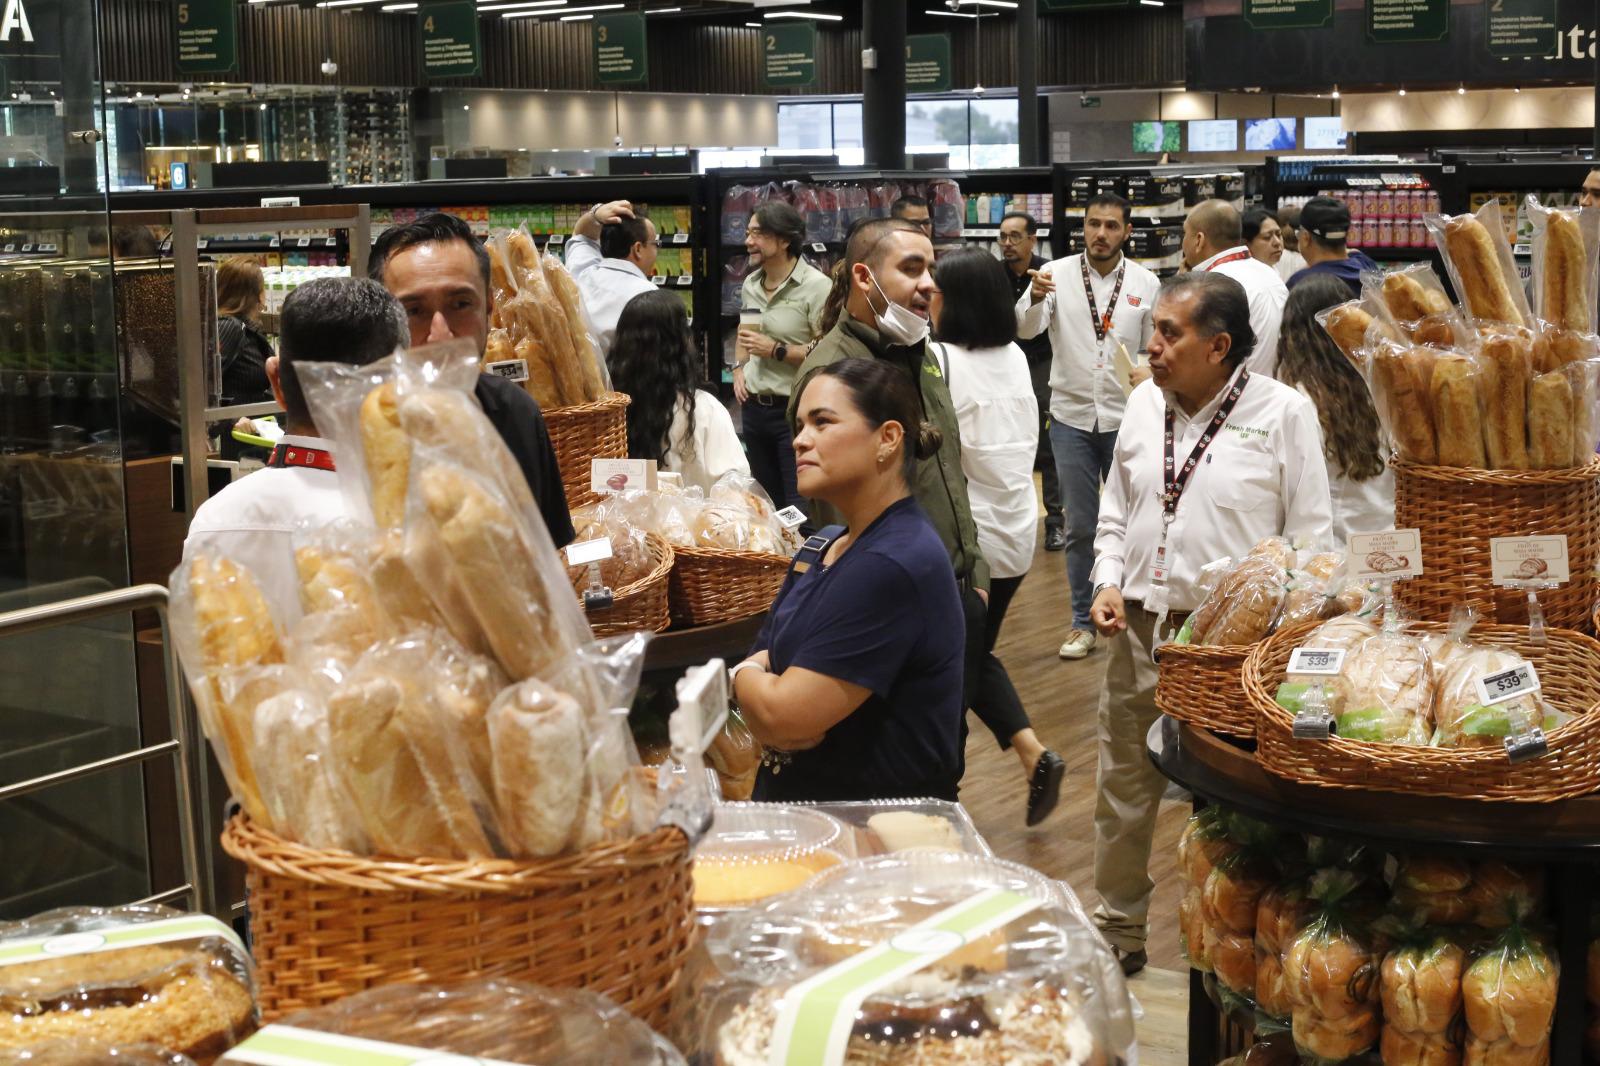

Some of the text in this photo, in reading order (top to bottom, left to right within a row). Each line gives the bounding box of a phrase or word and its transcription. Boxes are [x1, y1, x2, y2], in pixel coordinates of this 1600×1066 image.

[178, 4, 189, 23] 5
[1491, 0, 1503, 12] 2
[424, 16, 435, 33] 4
[598, 25, 608, 43] 3
[766, 35, 776, 51] 2
[173, 167, 183, 184] 6
[1224, 423, 1269, 437] Fresh Market
